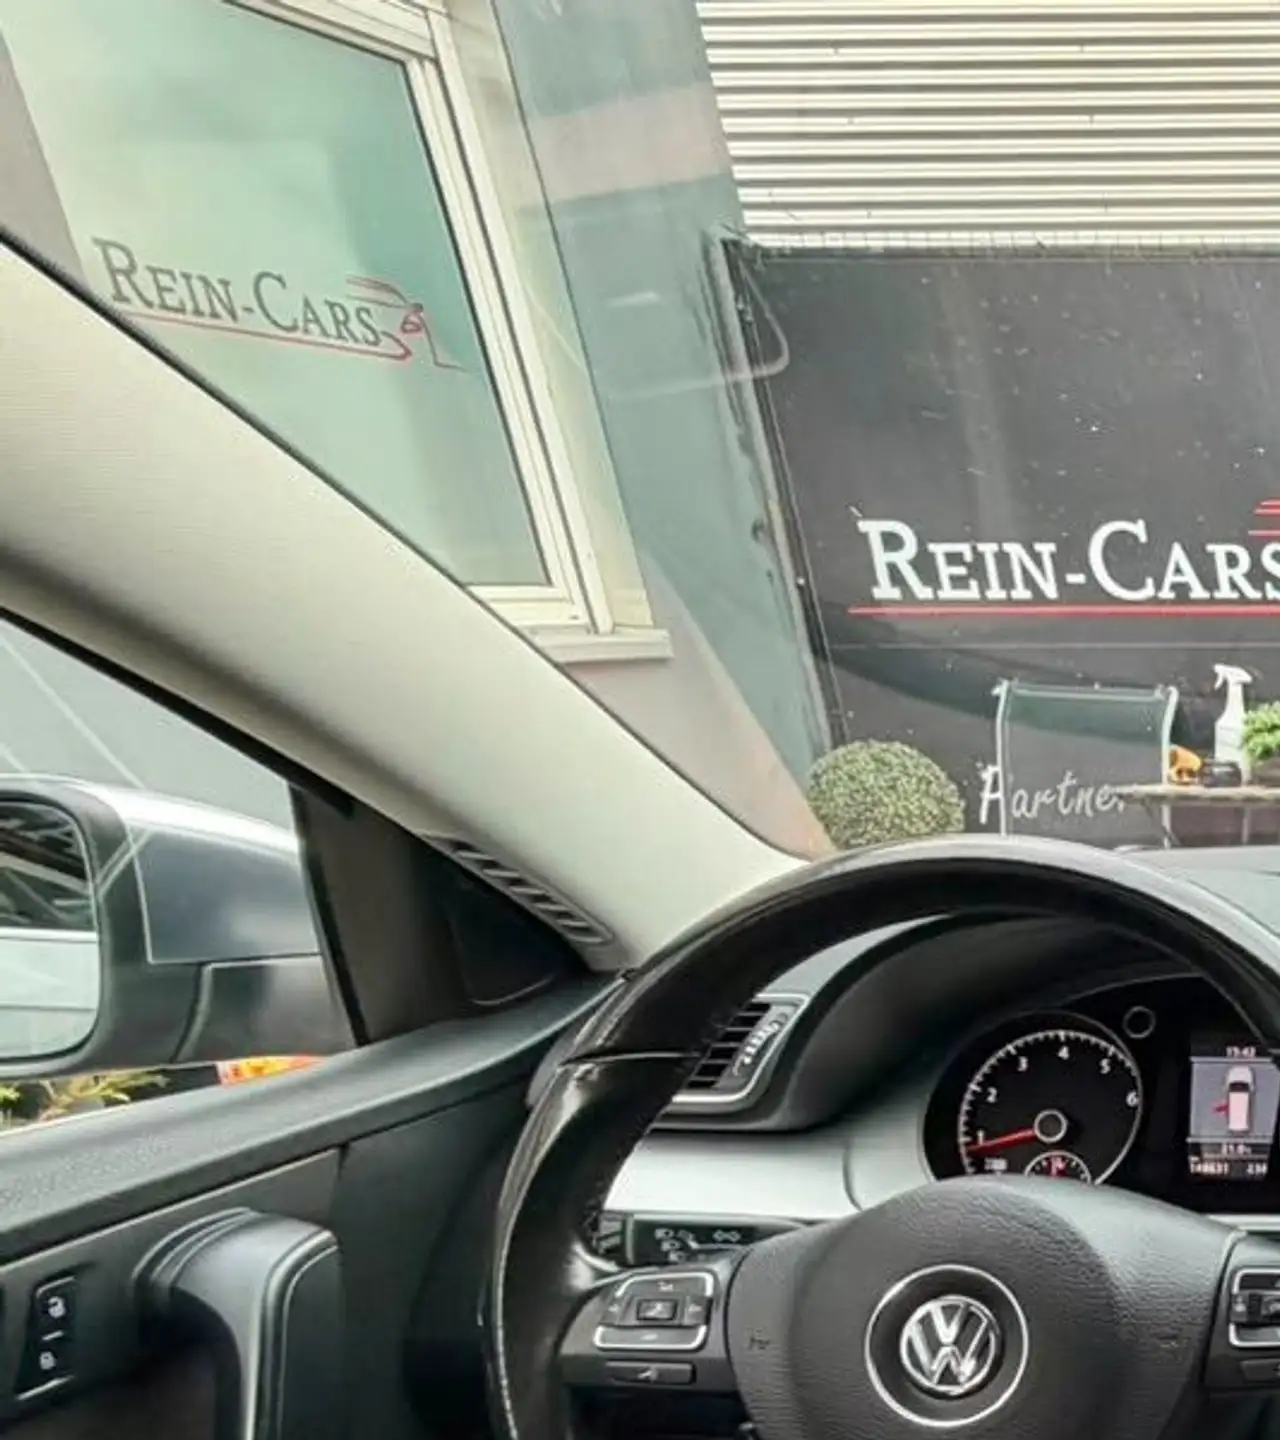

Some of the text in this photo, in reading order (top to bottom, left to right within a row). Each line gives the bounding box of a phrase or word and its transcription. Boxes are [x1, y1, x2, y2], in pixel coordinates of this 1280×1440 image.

[1057, 1046, 1070, 1060] 4
[1017, 1056, 1029, 1072] 3
[1100, 1058, 1111, 1074] 5
[986, 1086, 998, 1103] 2
[1126, 1091, 1139, 1107] 6
